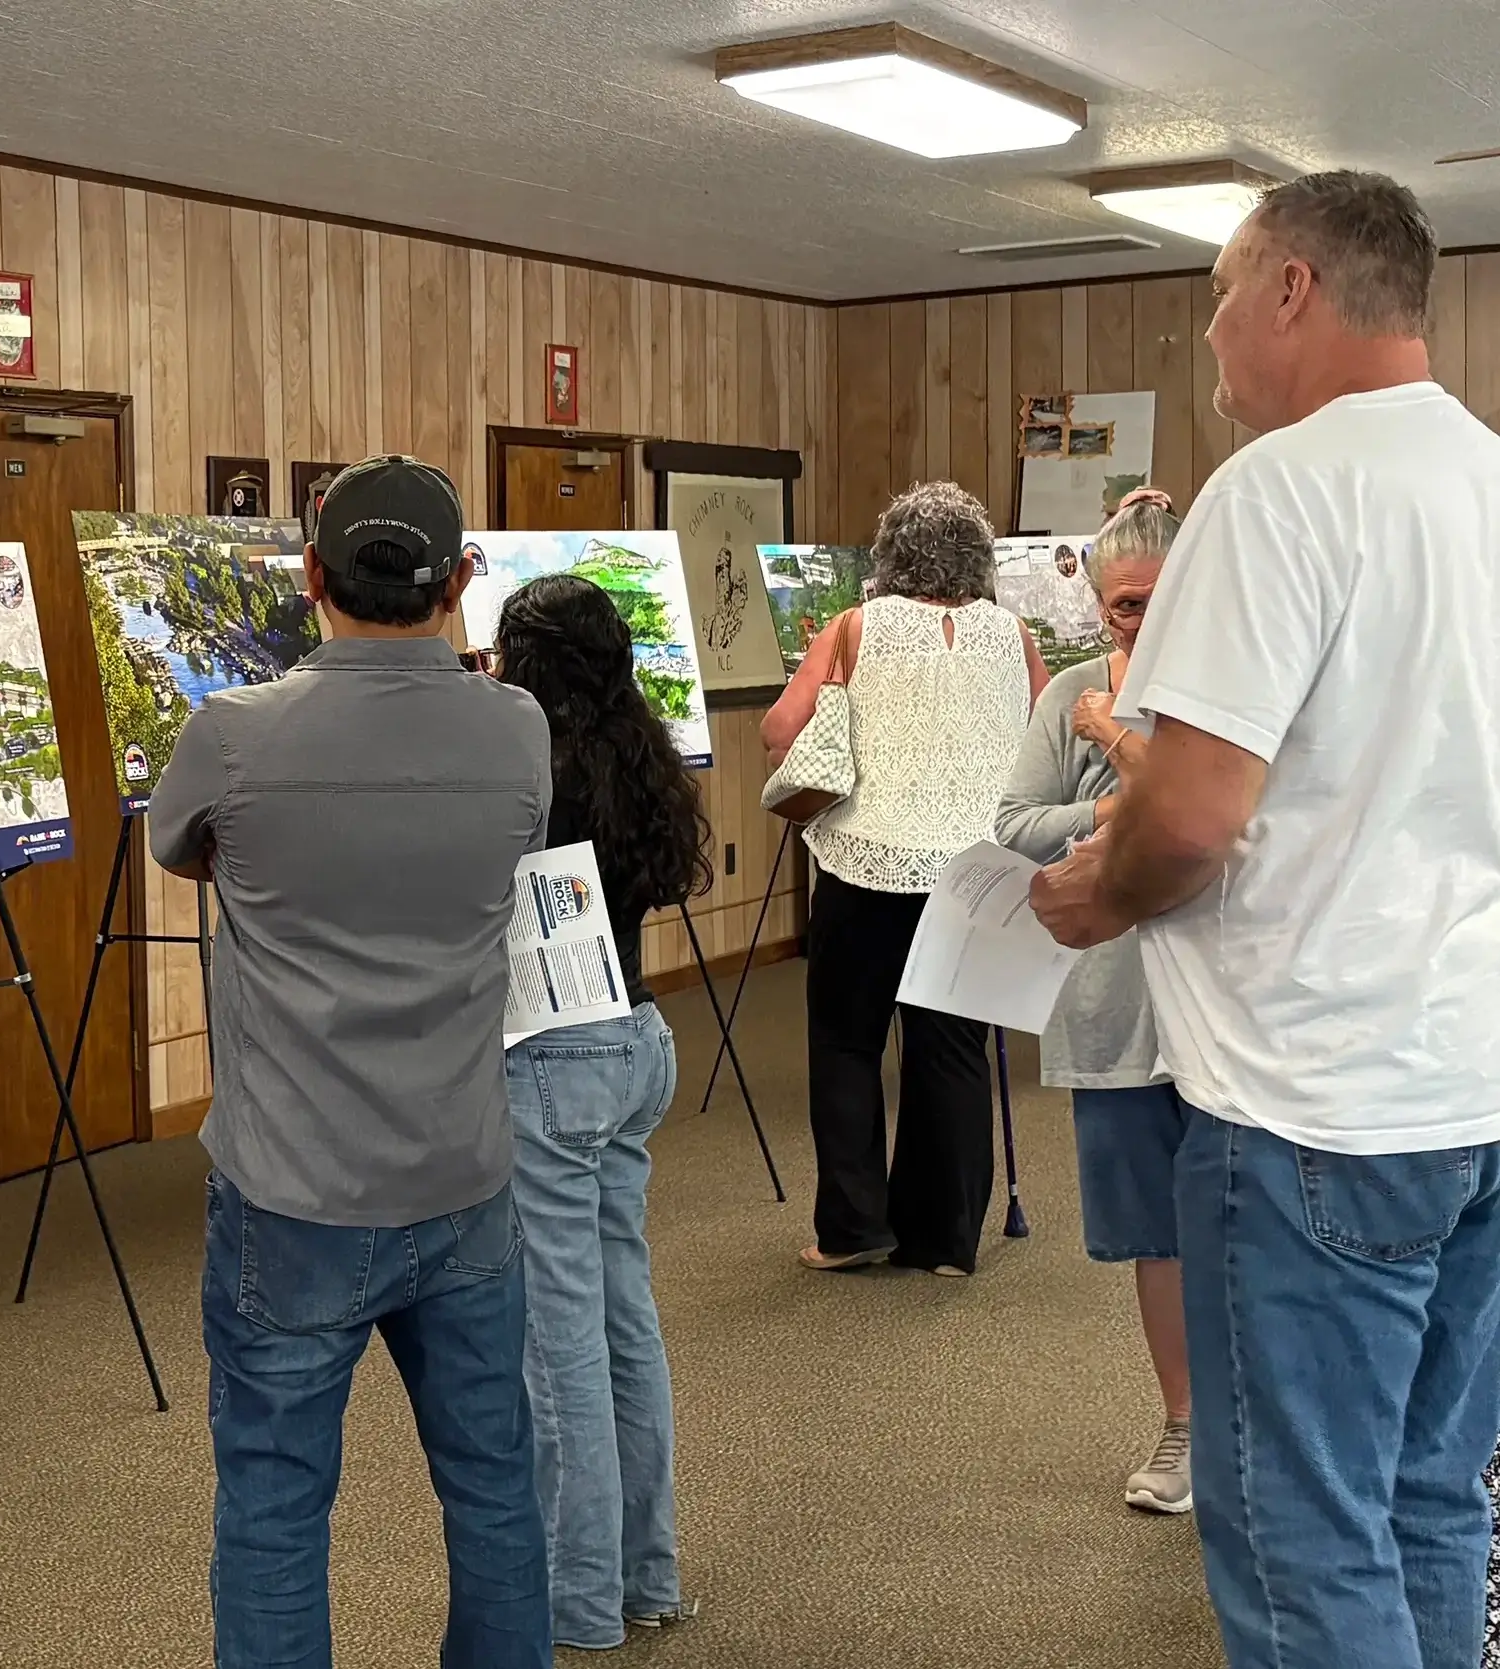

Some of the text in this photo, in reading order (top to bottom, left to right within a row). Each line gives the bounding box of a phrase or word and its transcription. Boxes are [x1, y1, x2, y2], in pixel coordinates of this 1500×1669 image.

[688, 492, 755, 537] CHIMNEY ROCK
[553, 880, 569, 918] ROCK
[563, 880, 575, 903] RAISE
